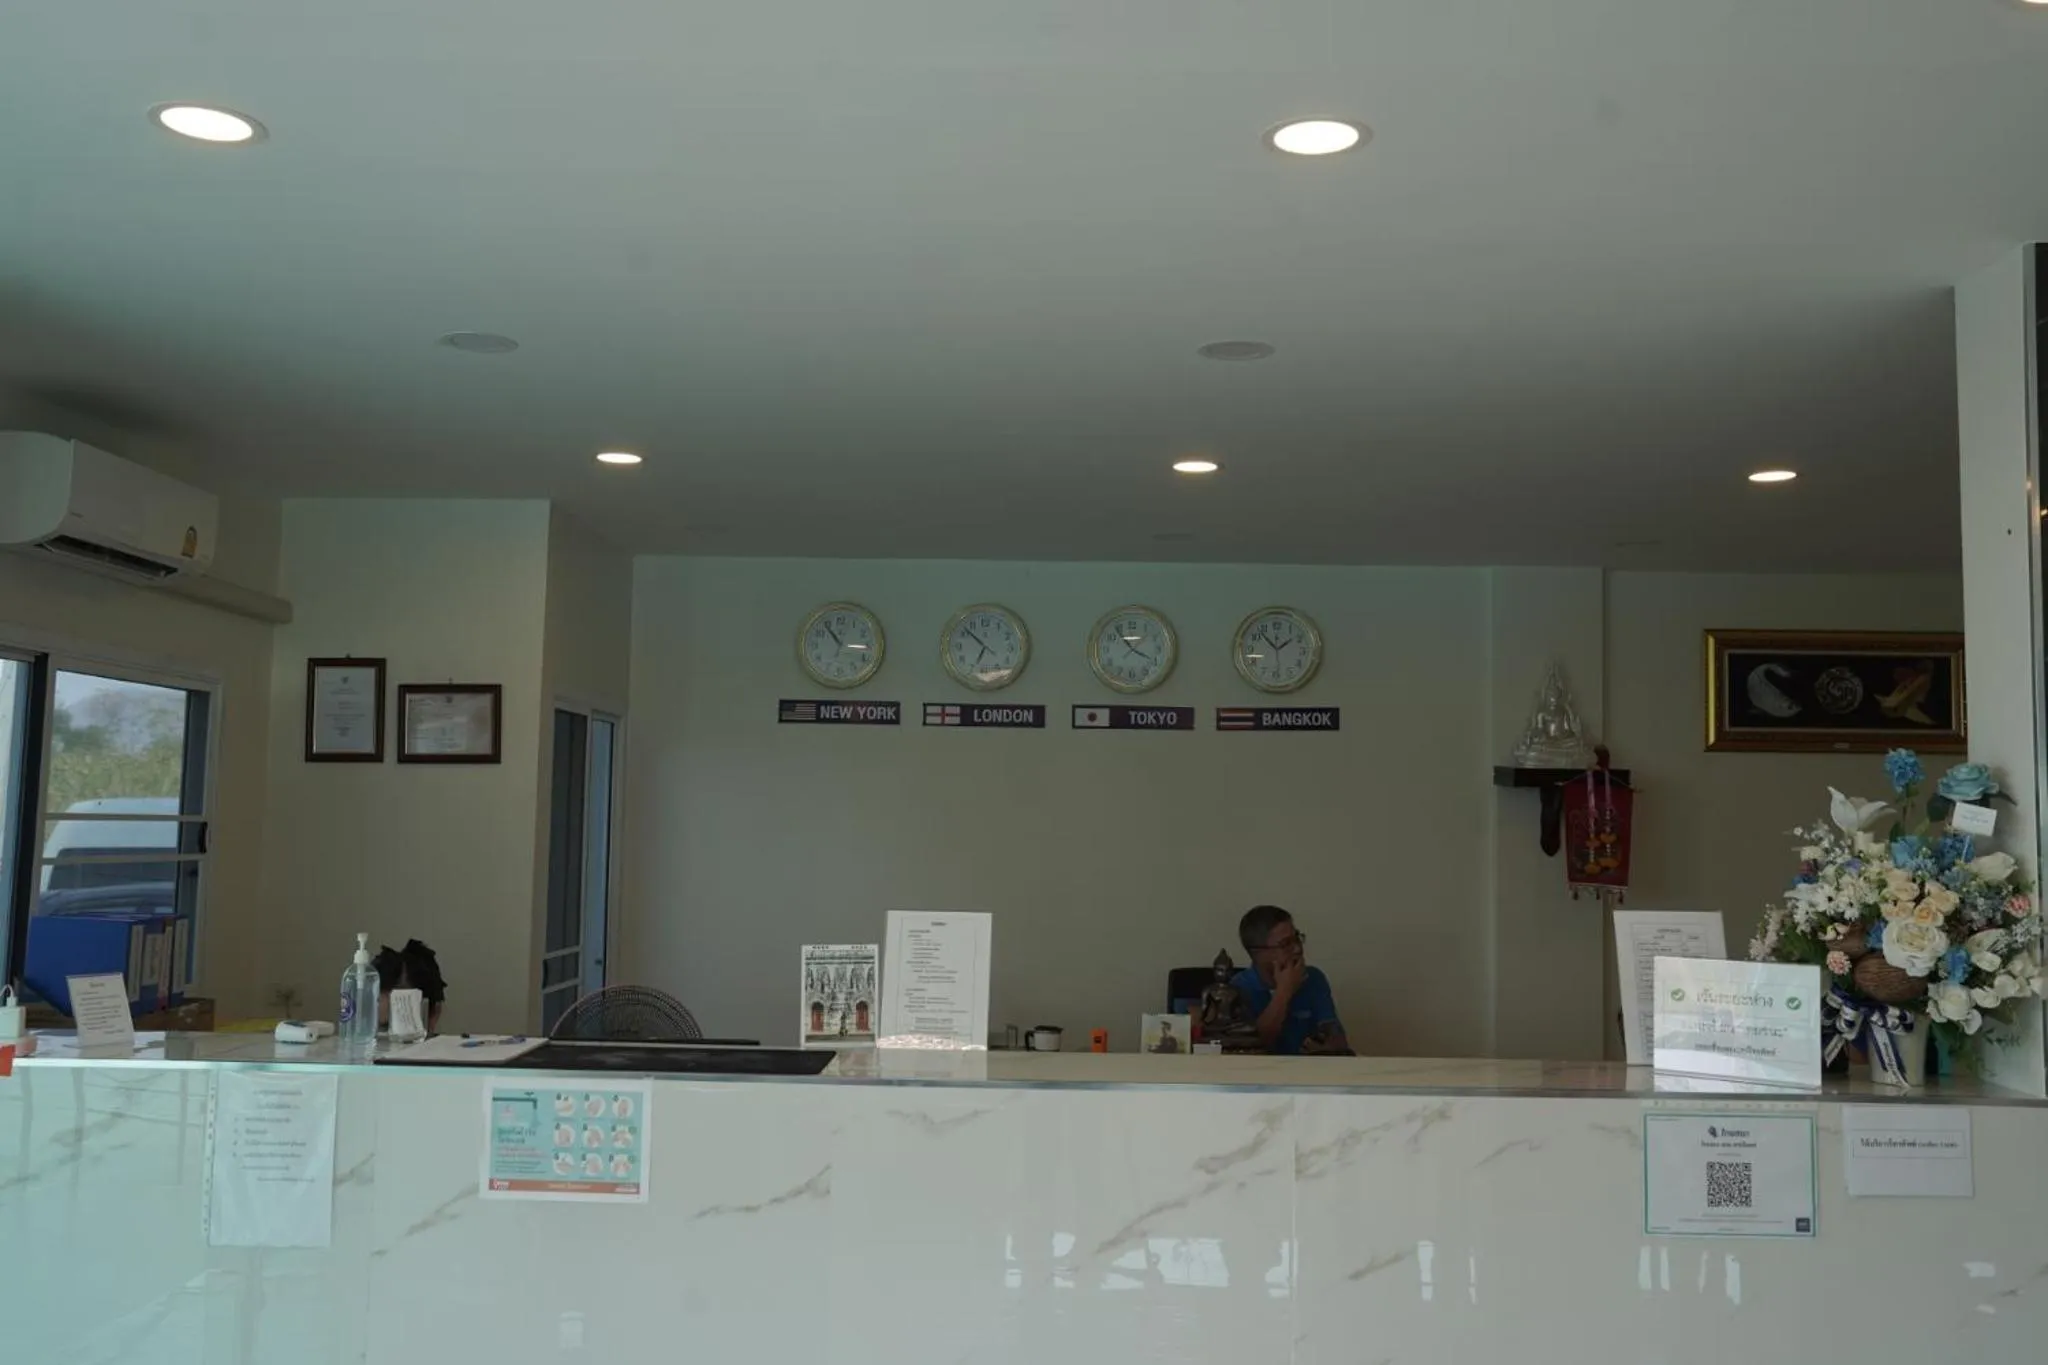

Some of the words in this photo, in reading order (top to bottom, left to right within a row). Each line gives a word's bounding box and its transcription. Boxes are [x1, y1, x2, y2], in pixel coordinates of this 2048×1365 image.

[819, 706, 853, 719] NEW
[857, 706, 896, 720] YORK
[973, 709, 1034, 723] LONDON
[1128, 711, 1177, 725] TOKYO
[1262, 712, 1331, 726] BANGKOK
